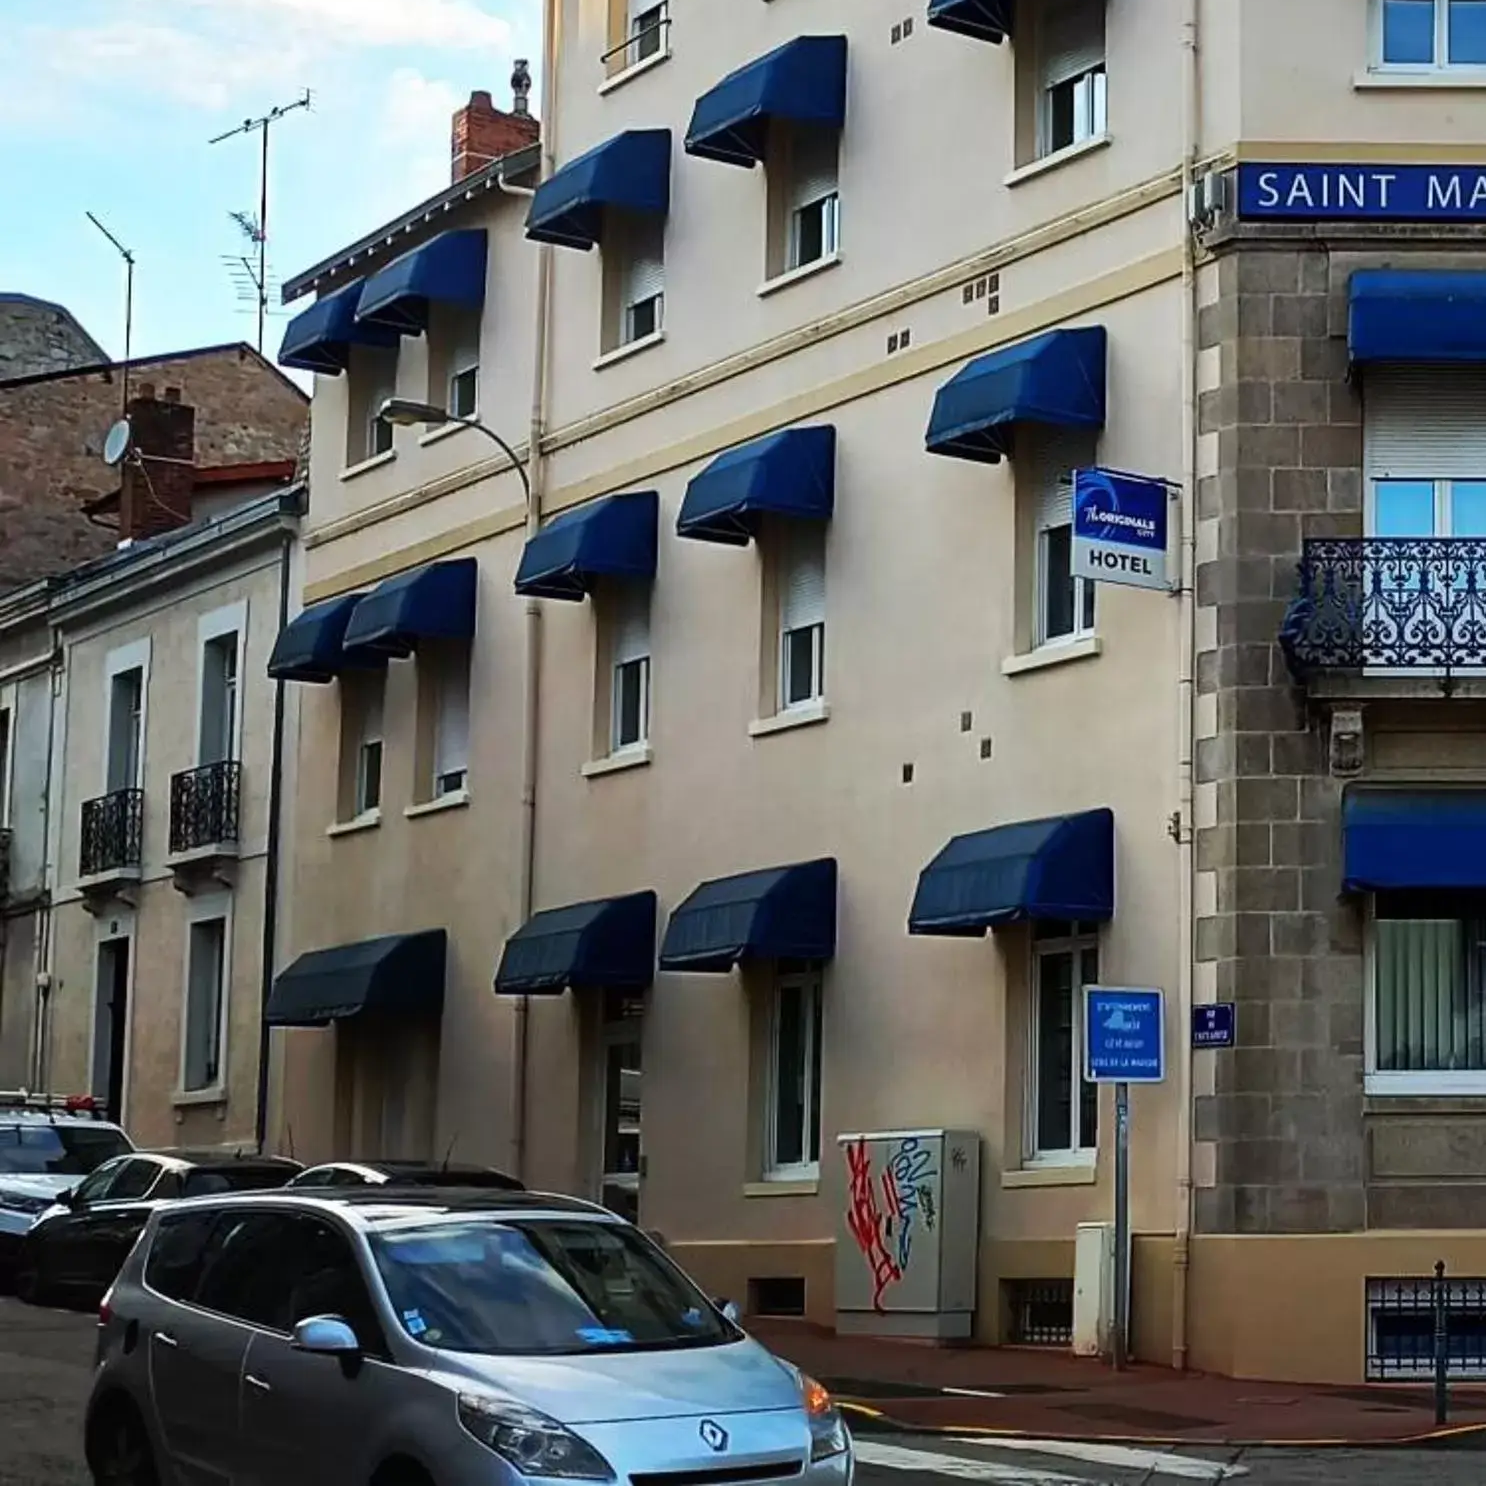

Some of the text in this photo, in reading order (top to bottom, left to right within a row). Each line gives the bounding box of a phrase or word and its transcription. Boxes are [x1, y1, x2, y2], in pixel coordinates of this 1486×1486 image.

[1257, 173, 1396, 208] SAINT
[1098, 511, 1155, 529] ORIGINALS
[1089, 550, 1152, 574] HOTEL
